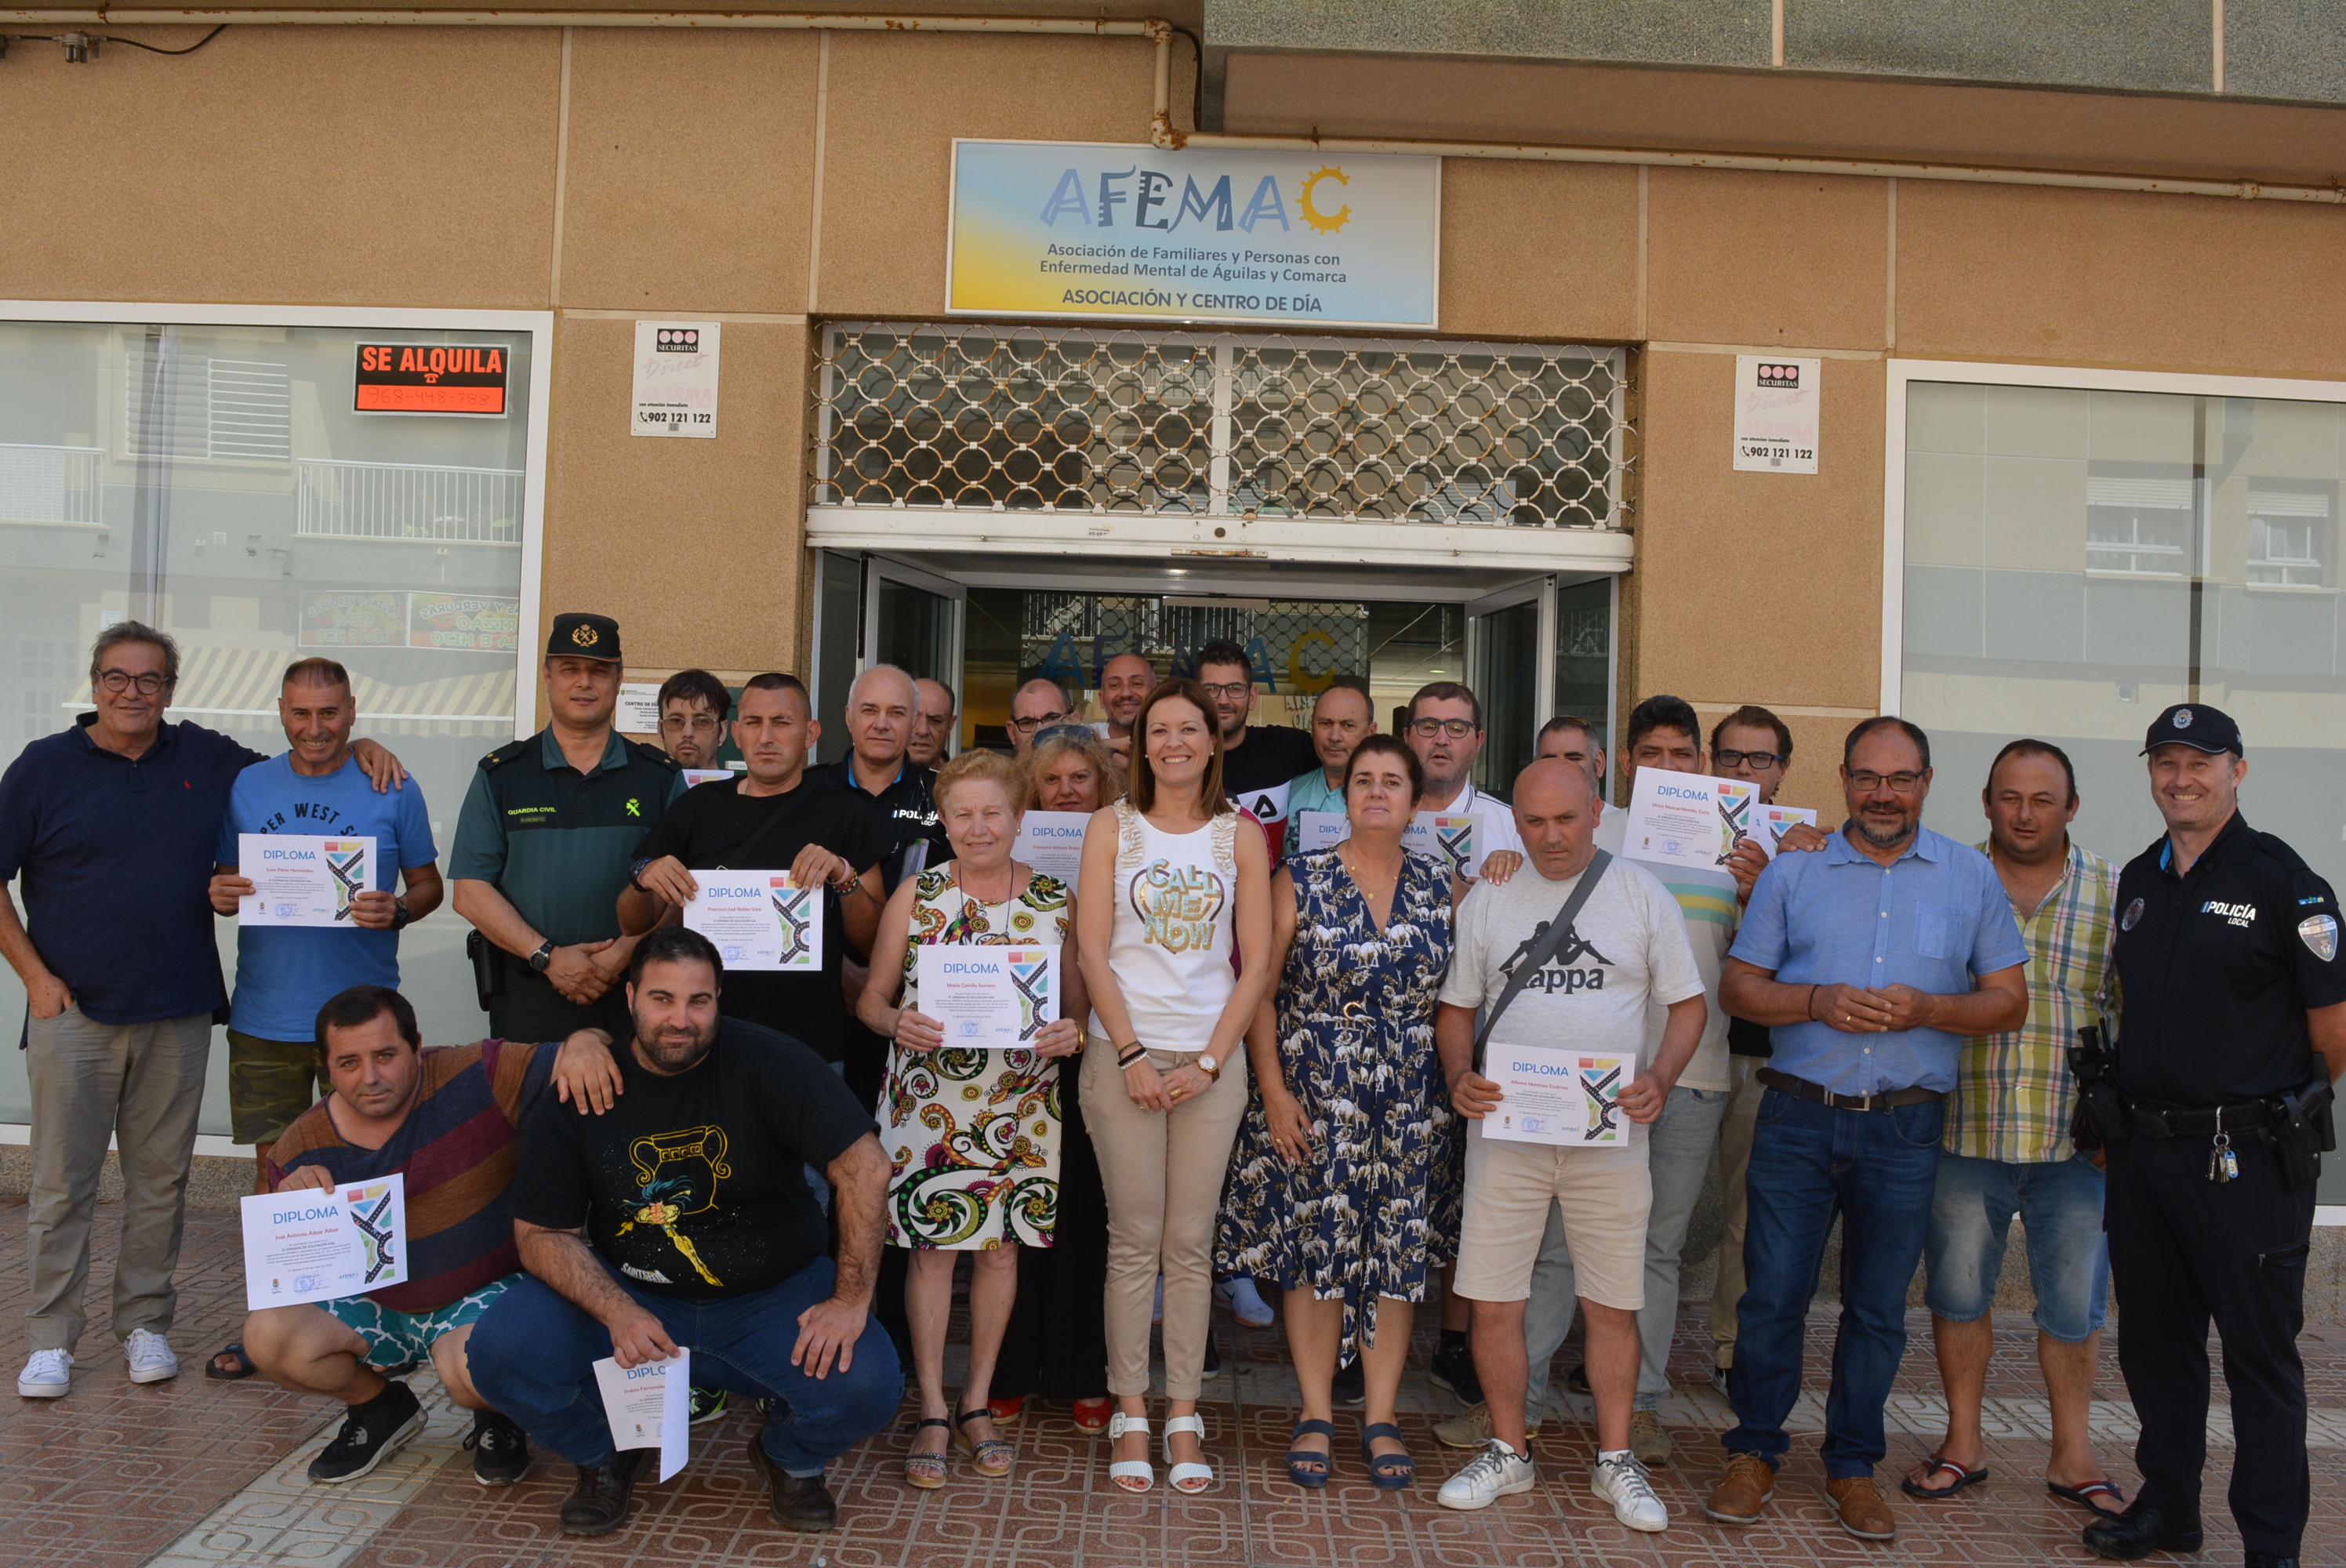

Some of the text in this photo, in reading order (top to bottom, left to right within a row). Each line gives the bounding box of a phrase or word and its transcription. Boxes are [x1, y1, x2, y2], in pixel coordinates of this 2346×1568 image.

[1040, 165, 1352, 235] AFEMAC
[1048, 244, 1340, 265] Asociación de Familiares y Personas con
[1040, 260, 1347, 283] Enfermedad Mental de Águilas y Comarca
[1062, 288, 1322, 312] ASOCIACIÓN Y CENTRO DE DÍA
[362, 347, 503, 375] SE ALQUILA
[1758, 379, 1798, 387] SECURITAS
[648, 412, 711, 423] 902 121 122
[1750, 447, 1813, 459] 902 121 122
[1658, 786, 1709, 801] DIPLOMA
[294, 802, 340, 824] WEST
[899, 809, 939, 821] POLÍA
[1033, 827, 1083, 837] DIPLOMA
[263, 850, 317, 860] DIPLOMA
[1146, 858, 1221, 898] CALL
[709, 887, 761, 898] DIPLOMA
[1153, 890, 1203, 921] ME
[2206, 901, 2257, 920] POLICÍA
[2228, 917, 2249, 927] LOCAL
[1143, 913, 1217, 953] NOW
[943, 964, 1000, 974] DIPLOMA
[1513, 1062, 1569, 1076] DIPLOMA
[273, 1205, 340, 1225] DIPLOMA
